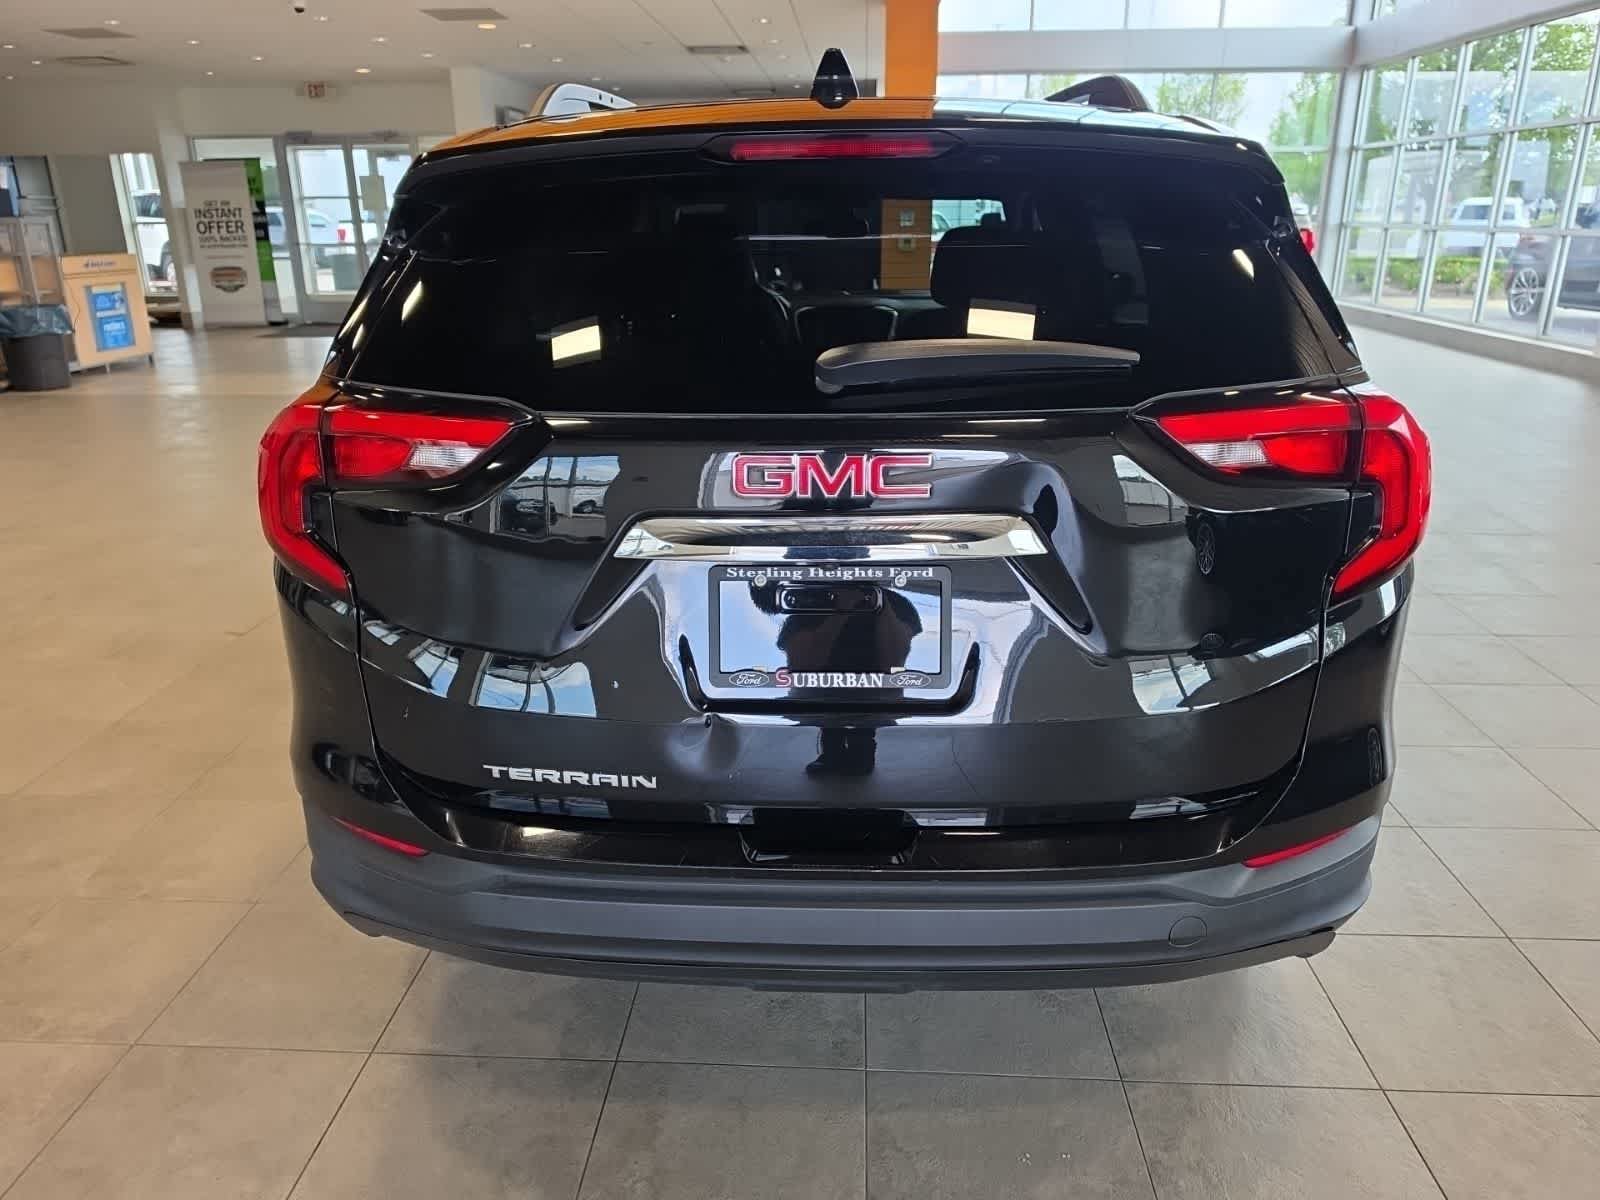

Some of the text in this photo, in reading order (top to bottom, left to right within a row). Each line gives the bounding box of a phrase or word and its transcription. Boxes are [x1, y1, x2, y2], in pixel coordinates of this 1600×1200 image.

[194, 208, 242, 219] INSTANT
[196, 220, 245, 234] OFFER
[733, 454, 931, 498] GMC
[726, 567, 933, 580] Sterling Heights Ford
[736, 673, 762, 686] Ford
[896, 673, 923, 687] Ford
[482, 764, 657, 789] TERRAIN
